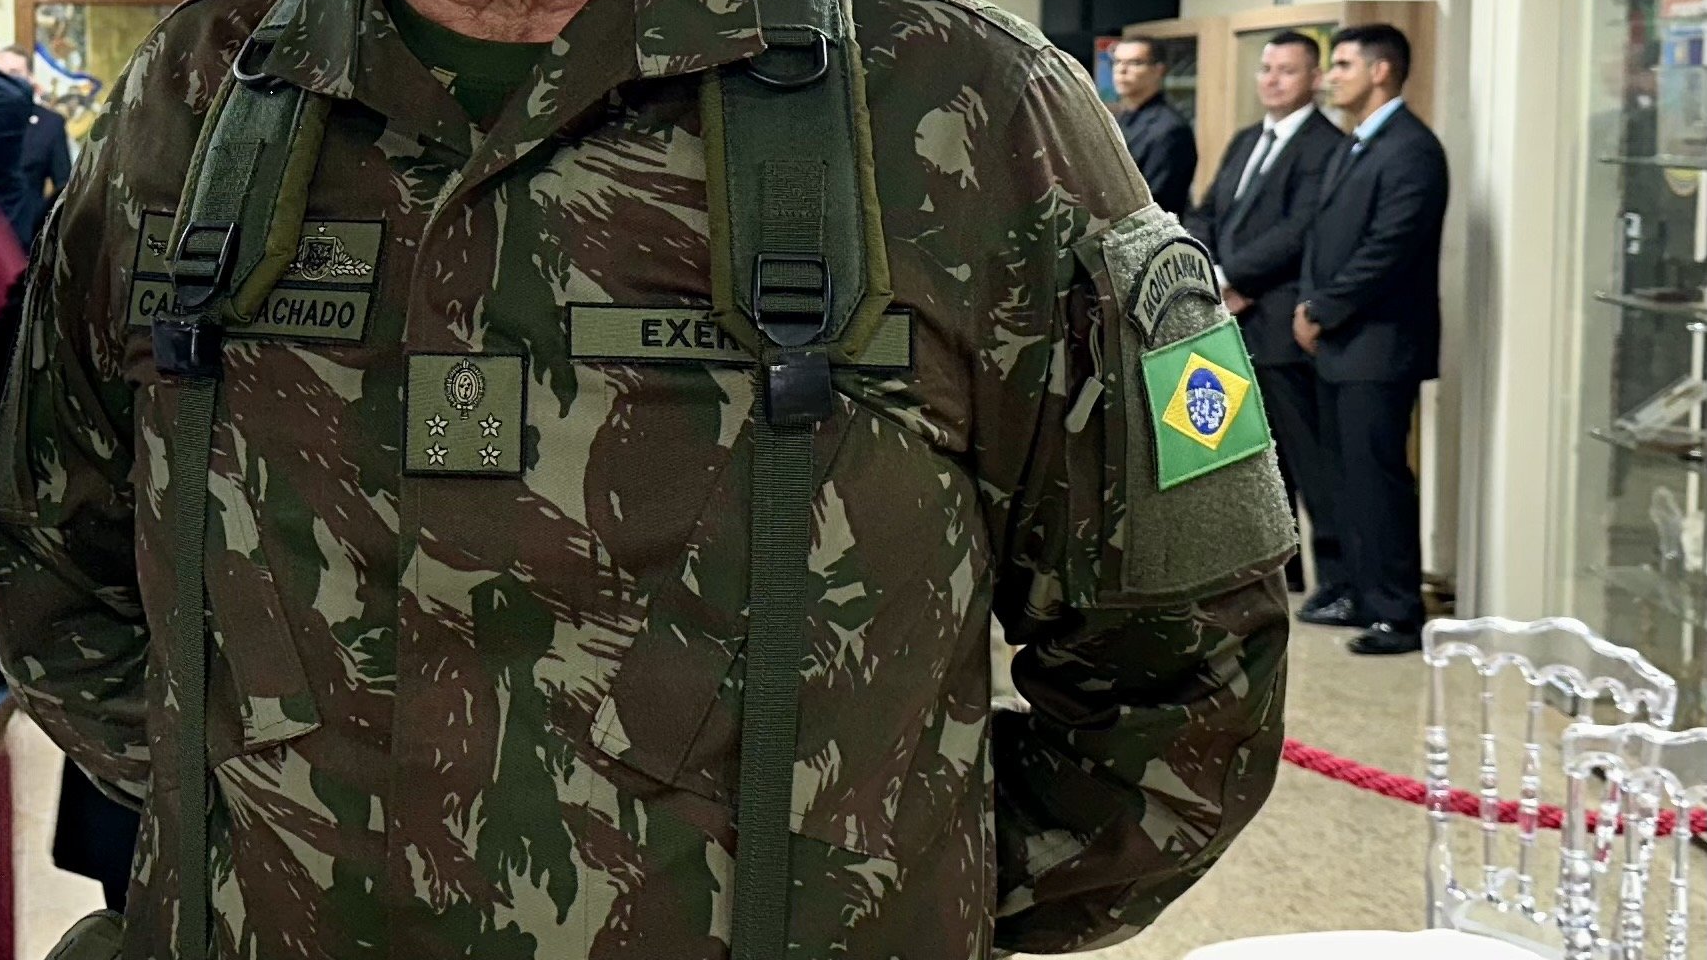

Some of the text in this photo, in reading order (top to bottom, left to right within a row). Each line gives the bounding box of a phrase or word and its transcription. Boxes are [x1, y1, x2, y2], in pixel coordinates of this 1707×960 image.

[1143, 252, 1210, 322] MONTANHA
[253, 293, 354, 329] ACHADO
[641, 313, 740, 351] EXÉR
